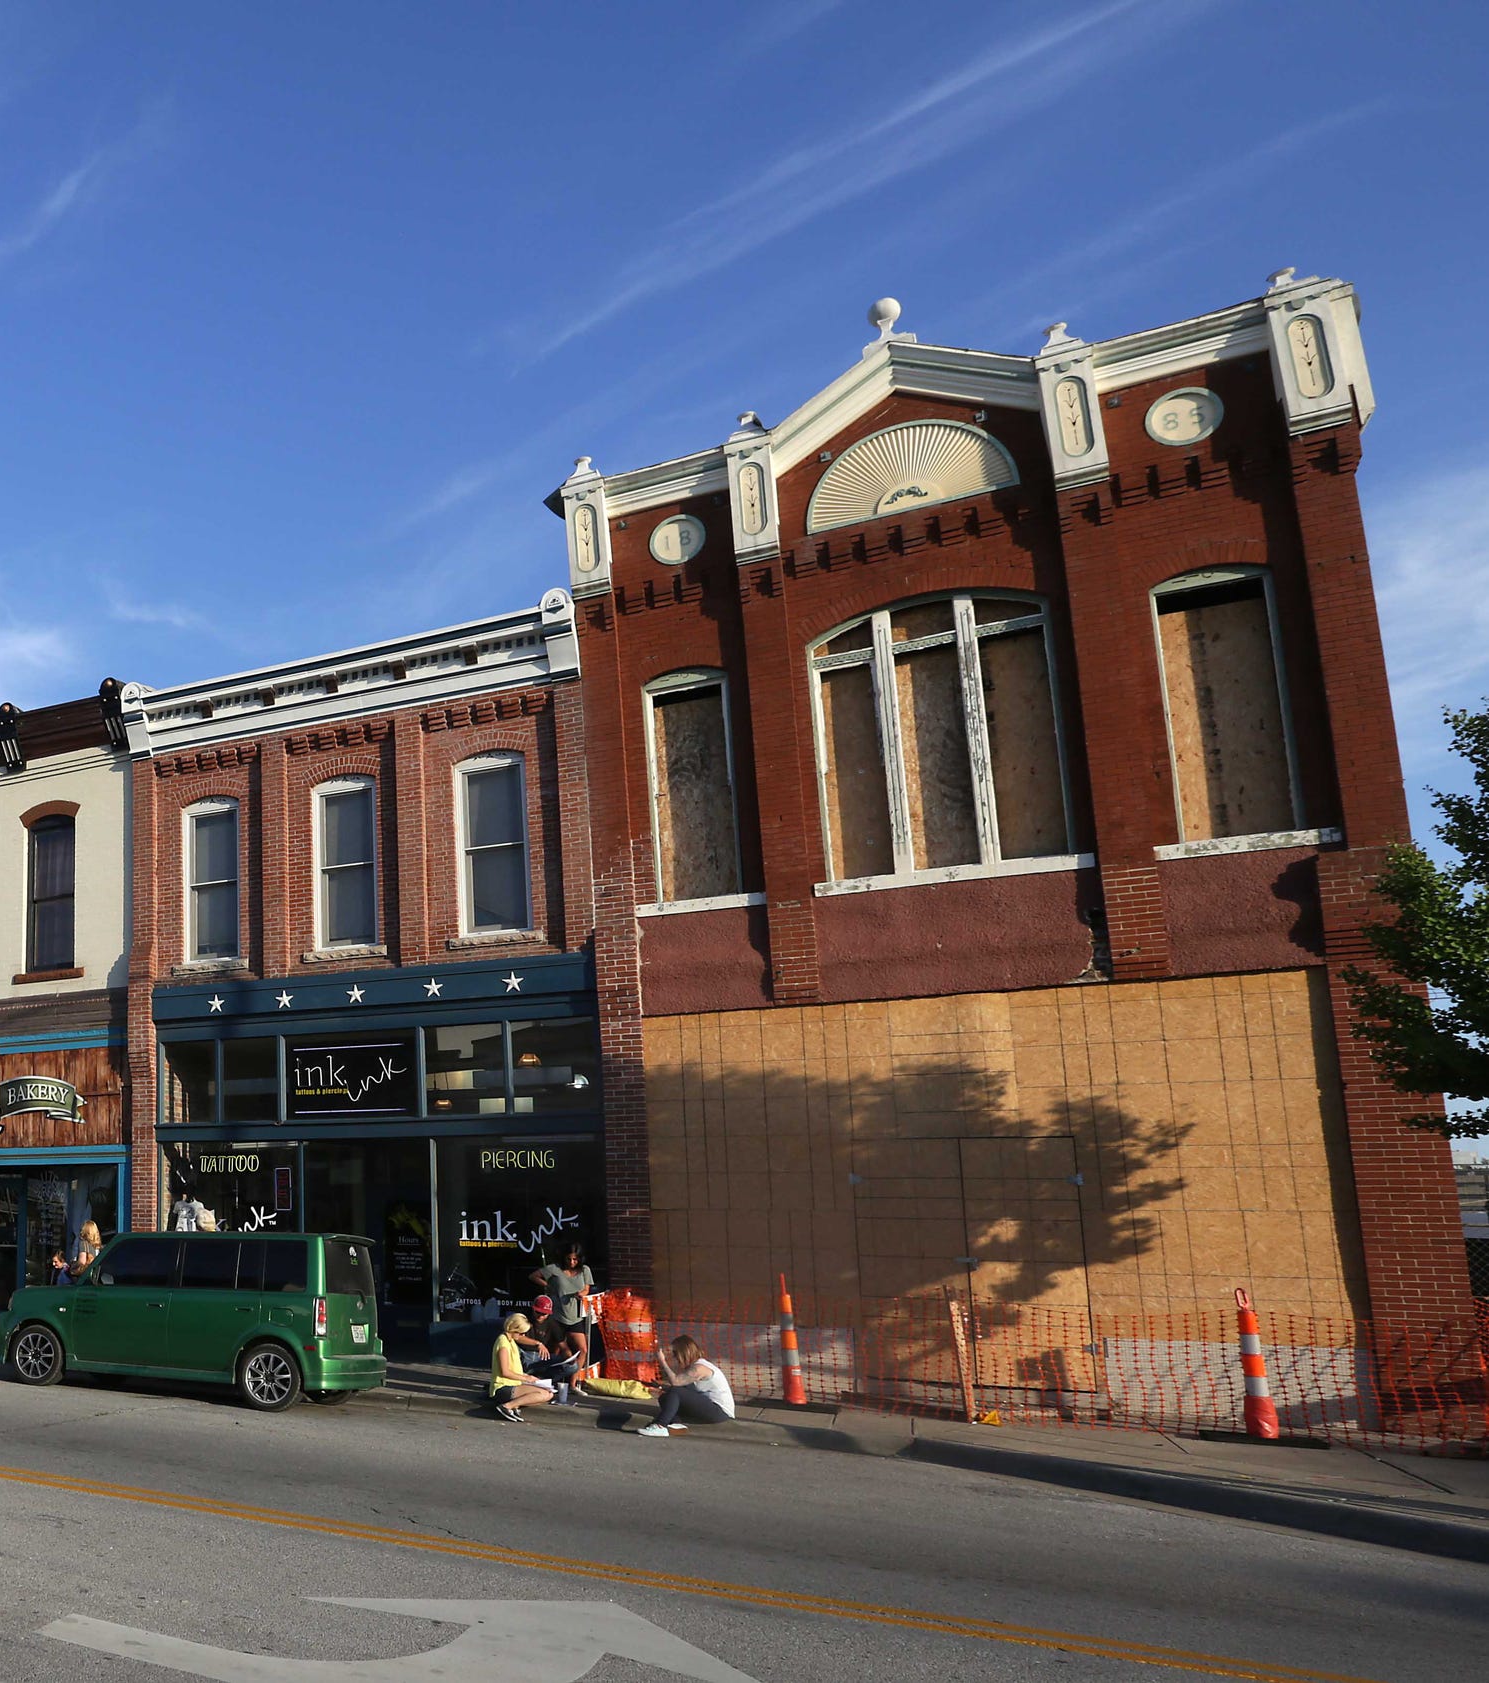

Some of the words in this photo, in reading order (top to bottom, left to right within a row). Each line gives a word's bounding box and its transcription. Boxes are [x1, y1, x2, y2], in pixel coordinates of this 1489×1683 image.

[1162, 405, 1206, 431] 85
[665, 529, 692, 551] 18
[294, 1054, 345, 1087] ink
[7, 1083, 70, 1106] BAKERY
[295, 1088, 316, 1096] tattoos
[199, 1154, 260, 1173] TATTOO
[481, 1149, 555, 1169] PIERCING
[459, 1210, 518, 1242] ink
[455, 1297, 482, 1305] TATTOOS
